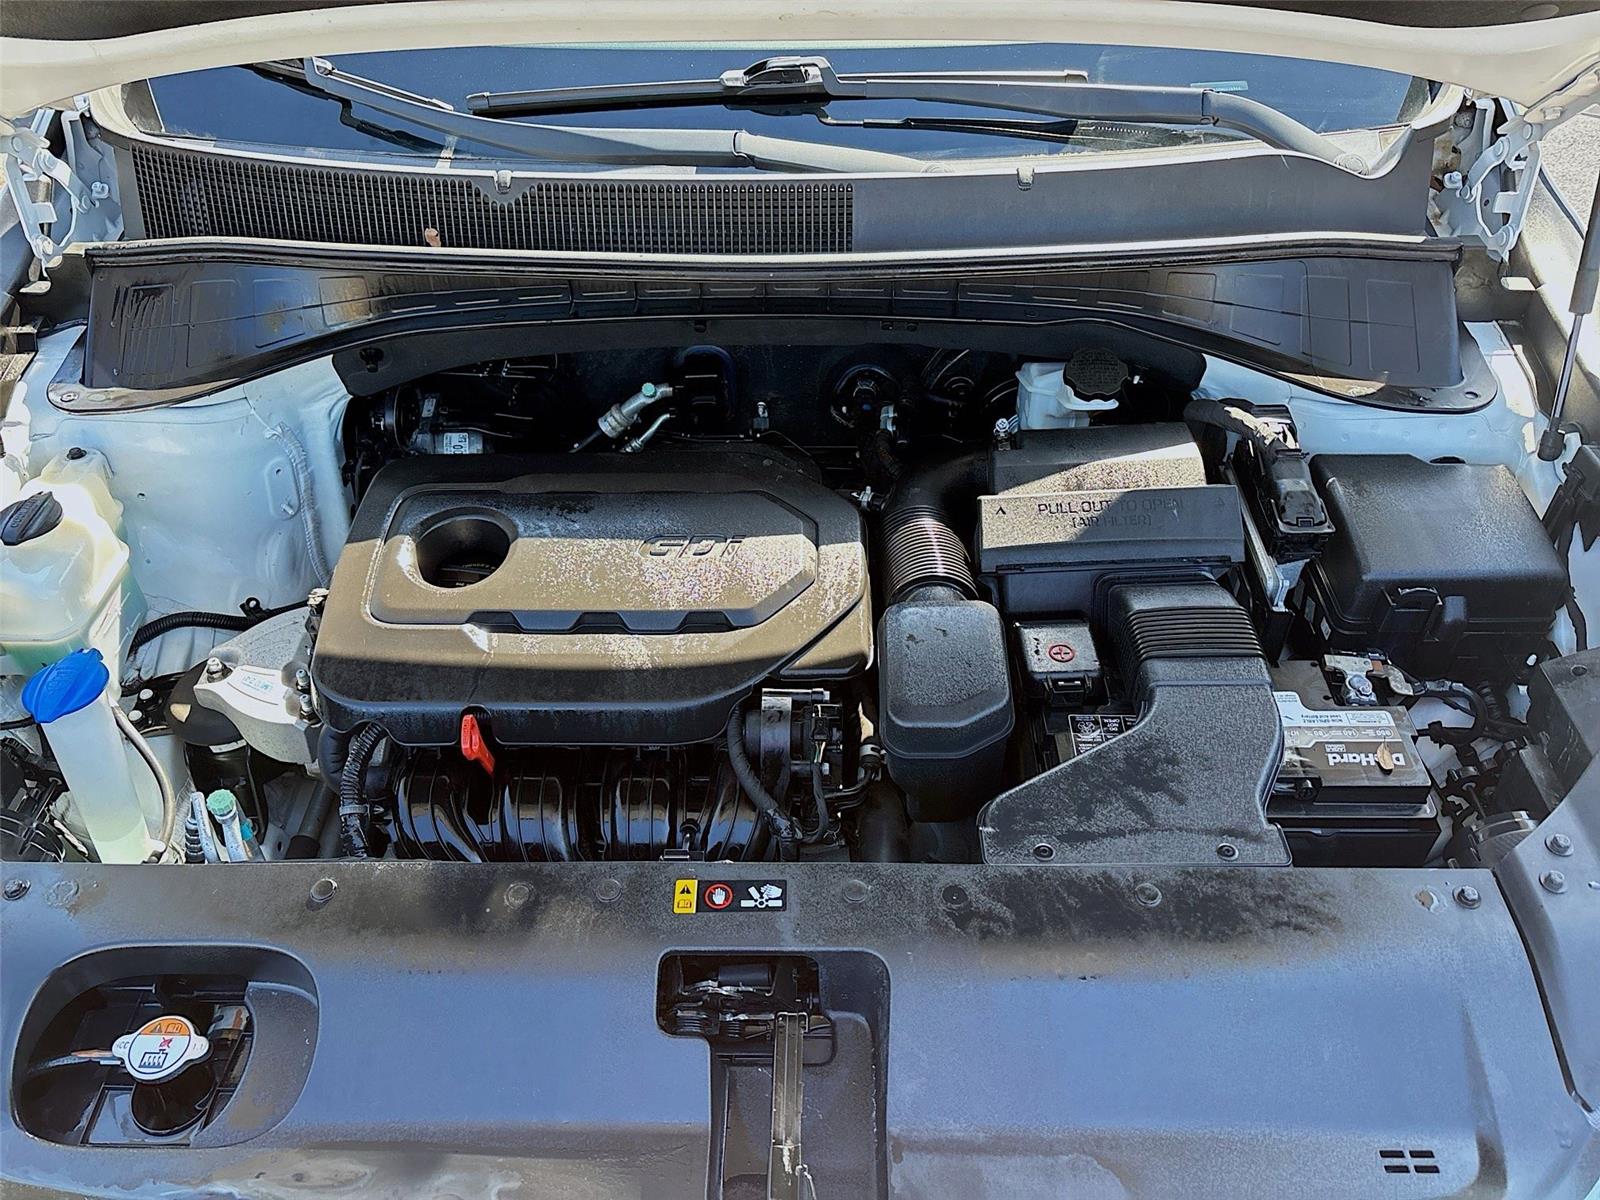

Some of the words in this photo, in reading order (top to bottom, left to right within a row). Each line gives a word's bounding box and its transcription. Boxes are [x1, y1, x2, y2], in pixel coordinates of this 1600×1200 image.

[1037, 502, 1079, 515] PULL
[1081, 499, 1113, 513] OUT
[1118, 499, 1137, 512] TO
[1328, 753, 1405, 766] DHard
